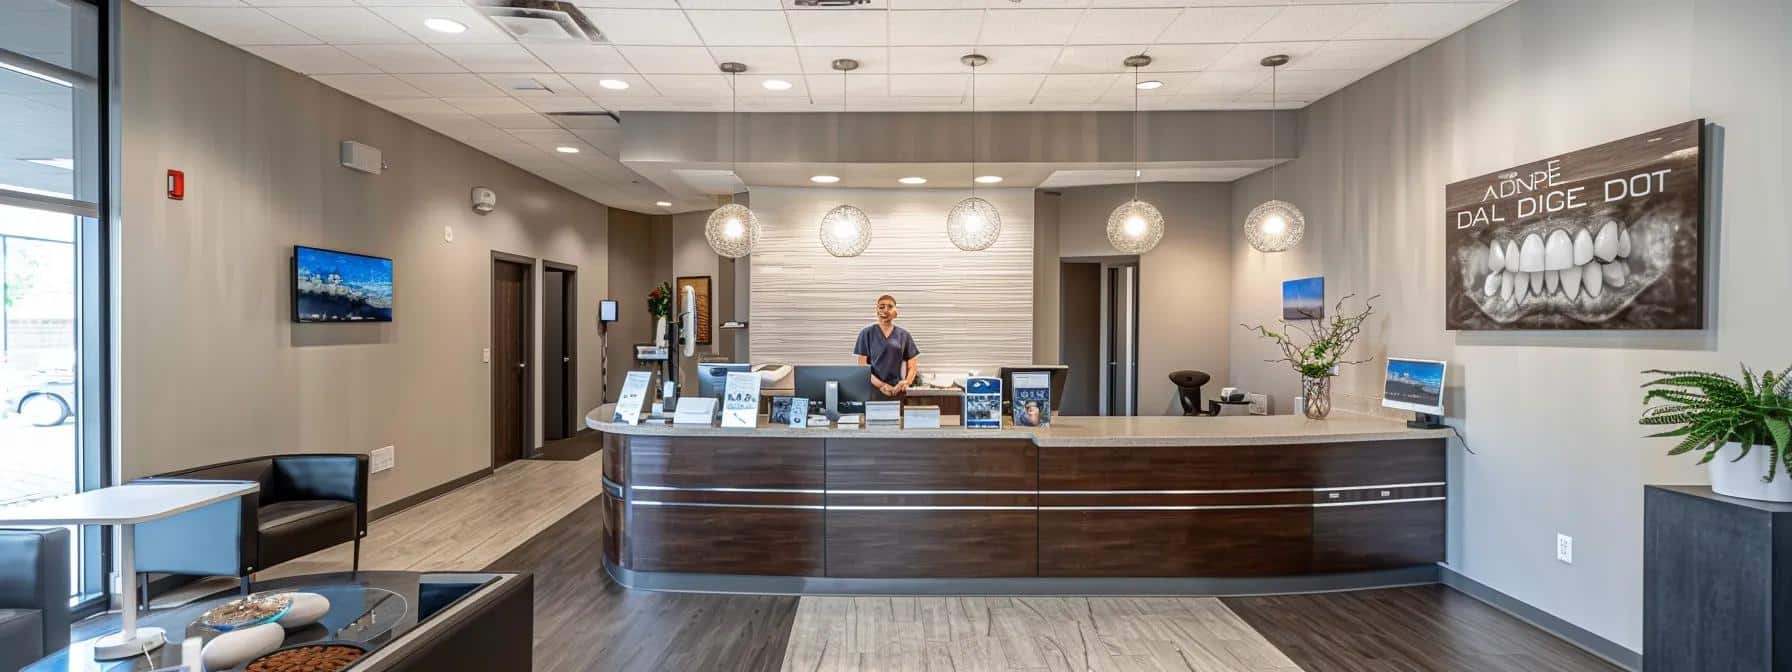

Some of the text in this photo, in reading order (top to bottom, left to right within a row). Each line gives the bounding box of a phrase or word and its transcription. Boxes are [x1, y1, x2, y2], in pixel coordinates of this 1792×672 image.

[1457, 168, 1672, 230] DAL DIGE DOT
